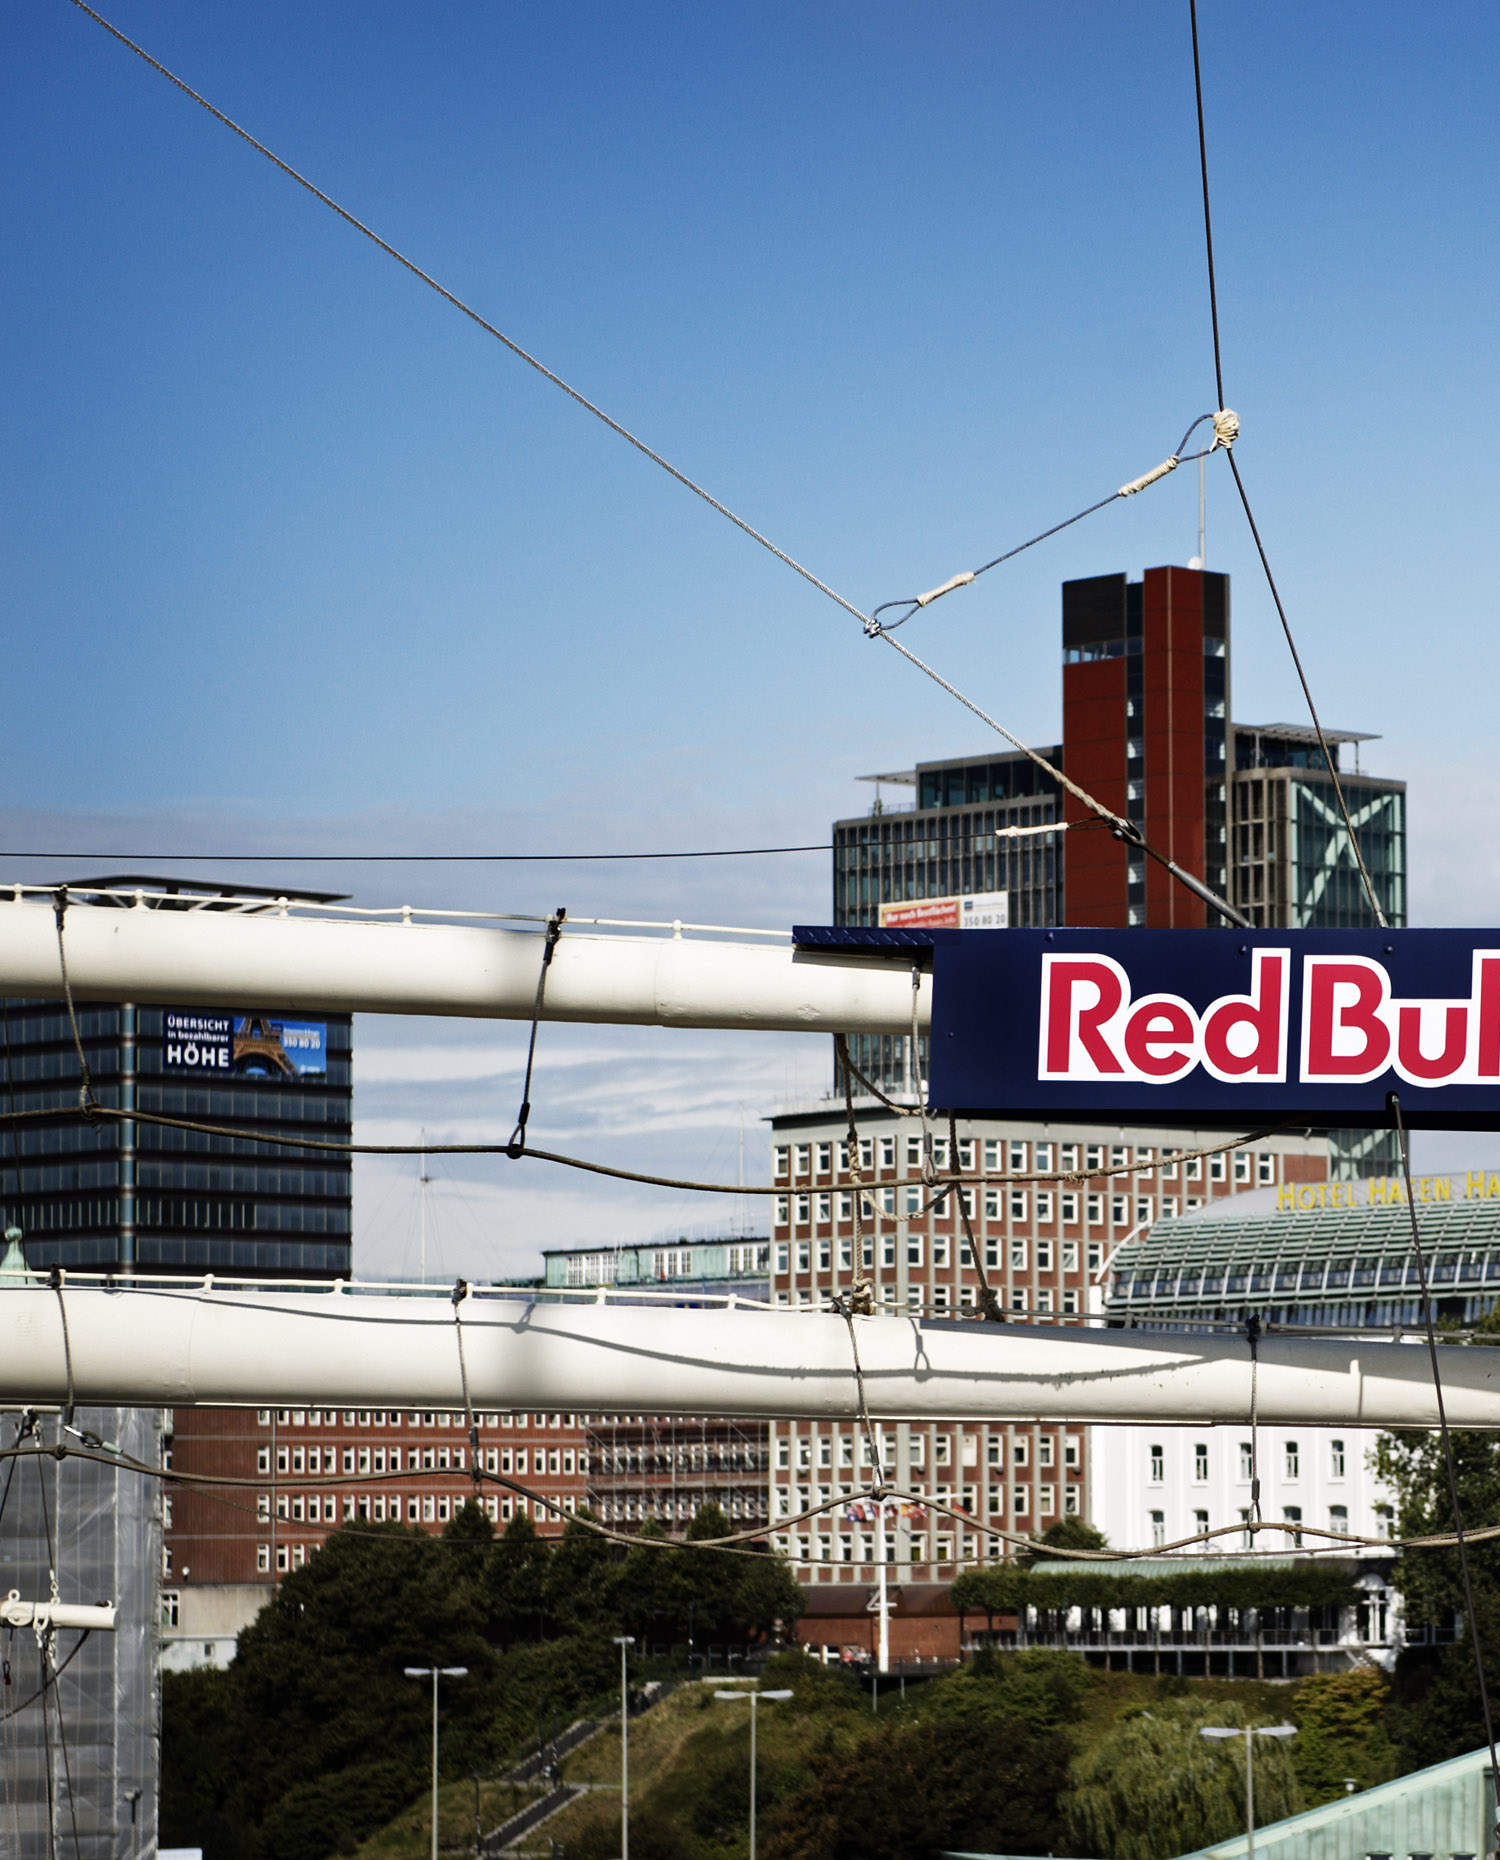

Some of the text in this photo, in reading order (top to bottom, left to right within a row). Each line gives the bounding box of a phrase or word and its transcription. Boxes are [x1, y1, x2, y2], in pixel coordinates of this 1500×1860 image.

[995, 913, 1006, 924] 20
[167, 1013, 229, 1032] ÜBERSICHT
[1038, 948, 1290, 1084] Red
[167, 1030, 229, 1043] in bezahlbarer
[167, 1041, 229, 1067] HÖHE
[1277, 1181, 1358, 1211] HOTEL
